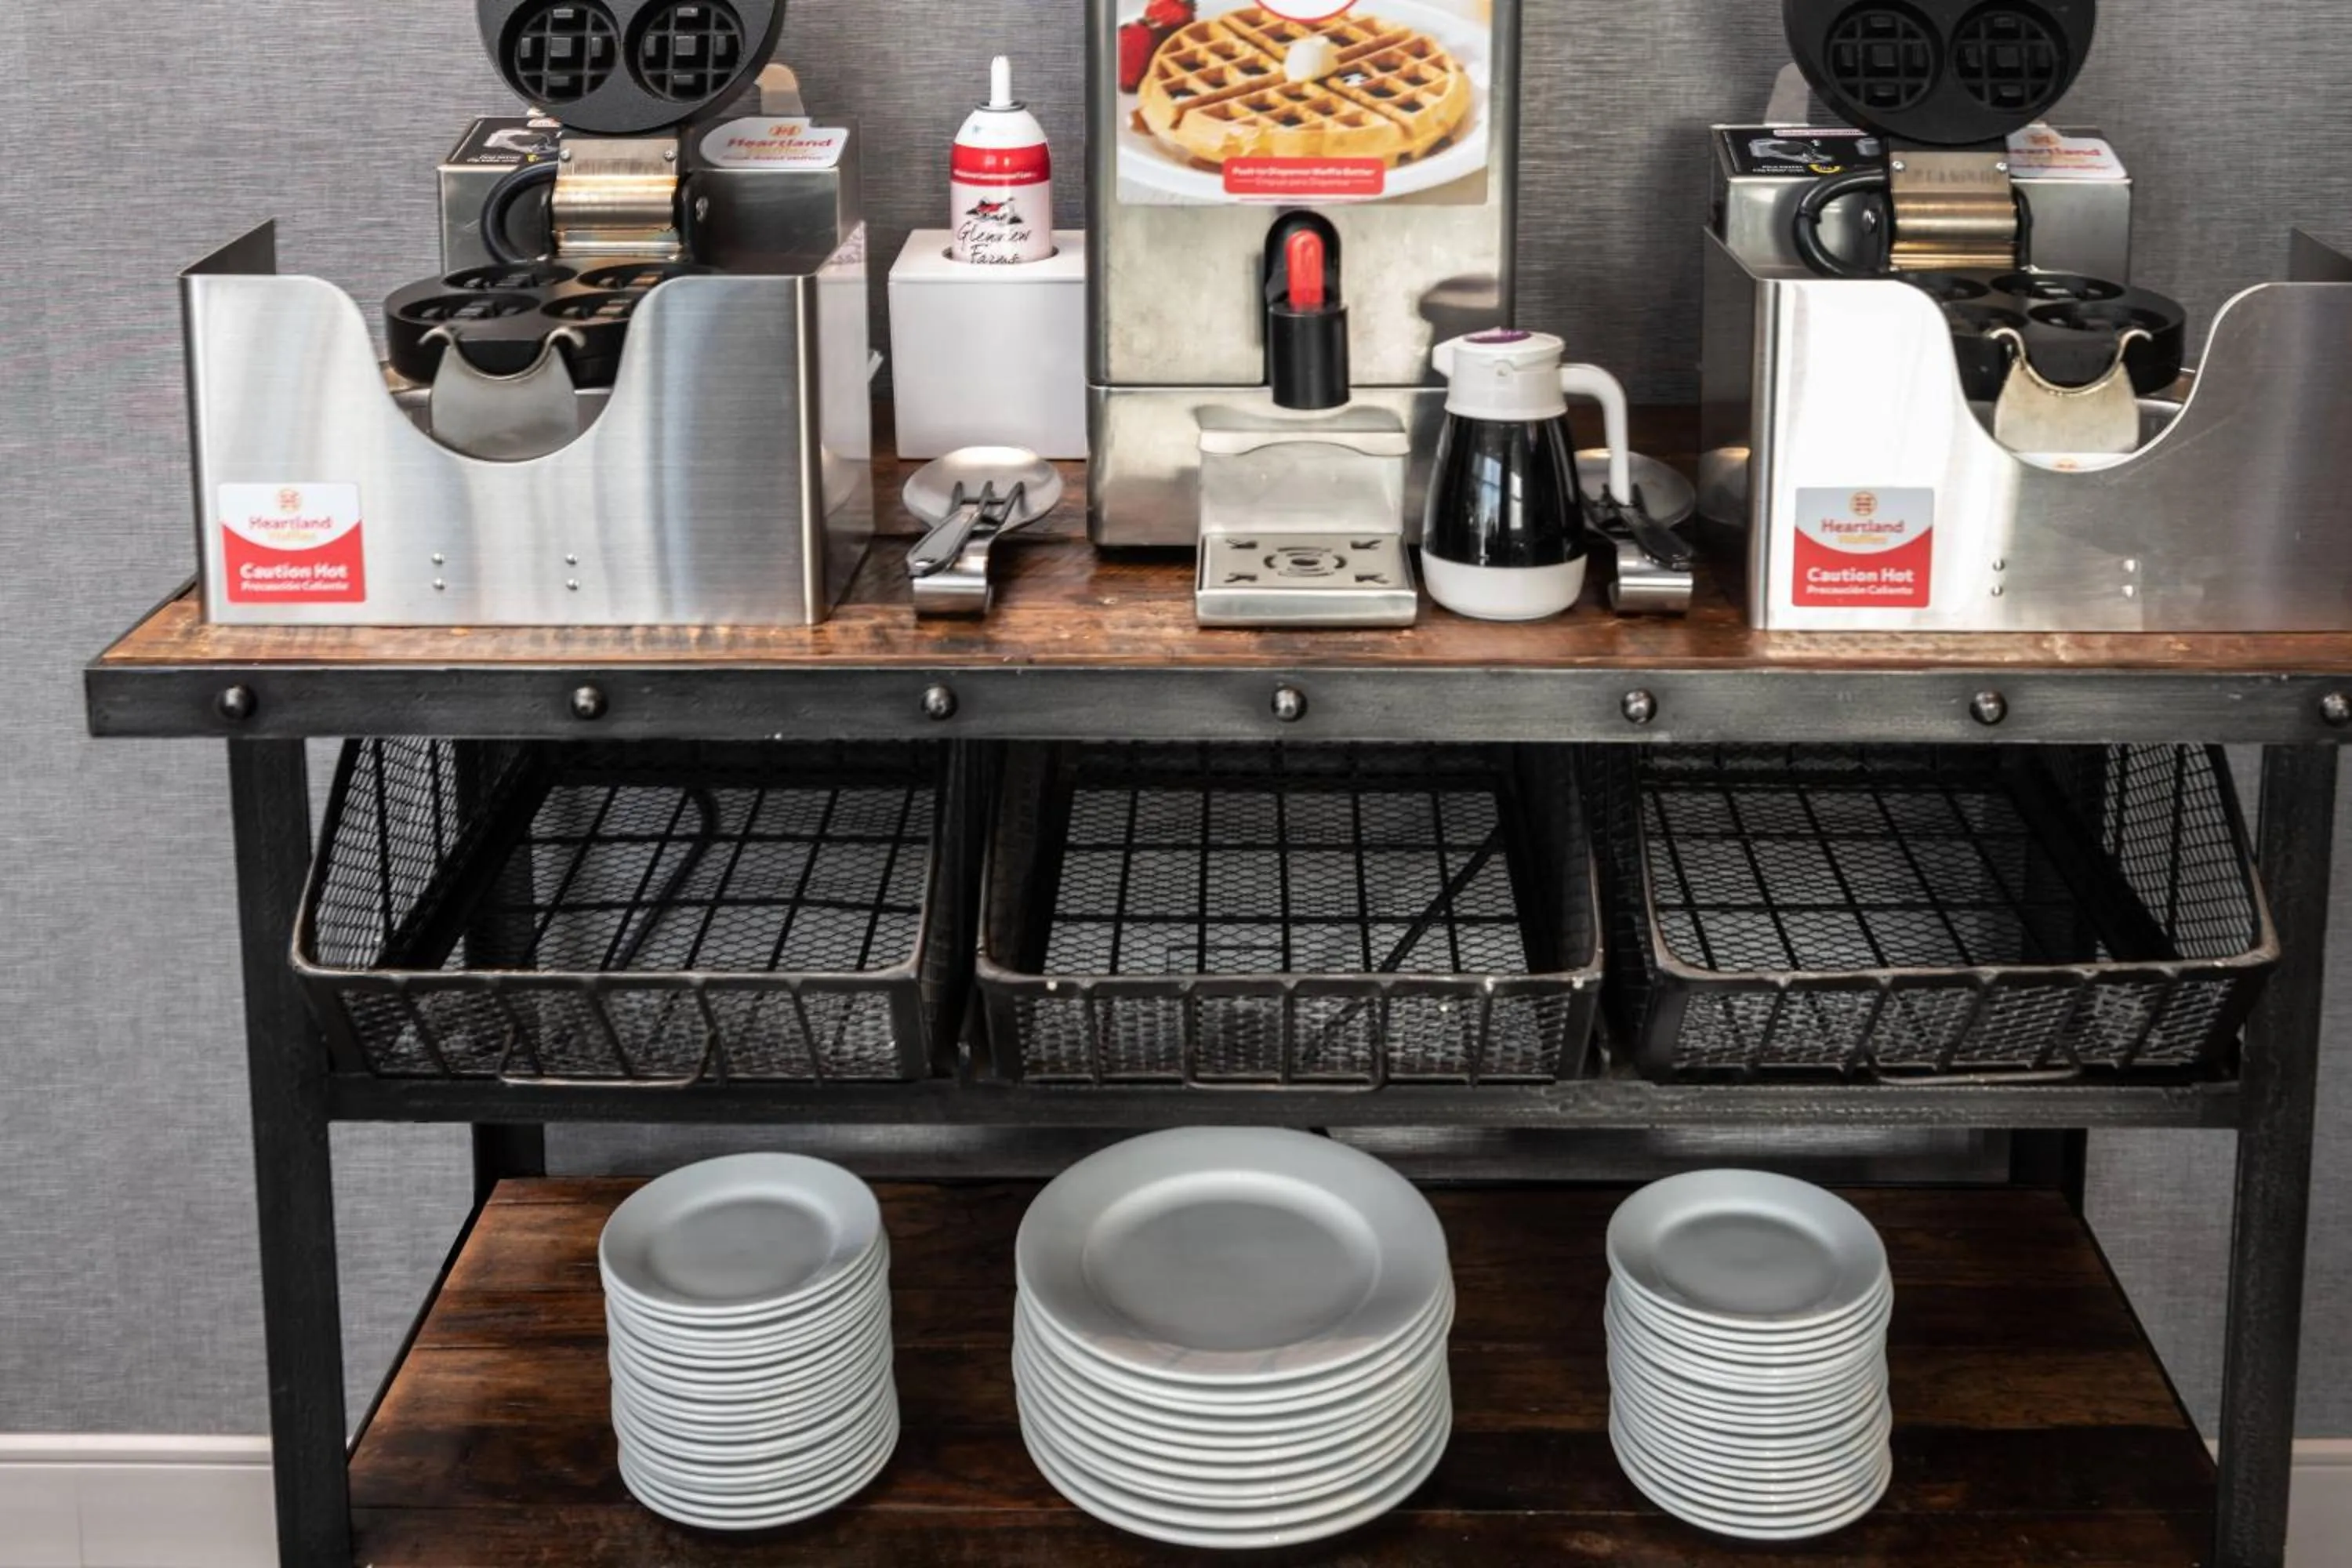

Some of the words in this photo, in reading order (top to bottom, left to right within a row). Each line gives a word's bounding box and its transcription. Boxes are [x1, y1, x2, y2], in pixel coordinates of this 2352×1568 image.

[727, 137, 833, 147] Heartland
[956, 220, 1033, 251] Glenvew
[248, 515, 332, 530] Heartland
[1820, 518, 1905, 534] Heartland
[239, 562, 312, 579] Caution
[314, 562, 348, 579] Hot
[1806, 567, 1878, 583] Caution
[1880, 568, 1915, 583] Hot
